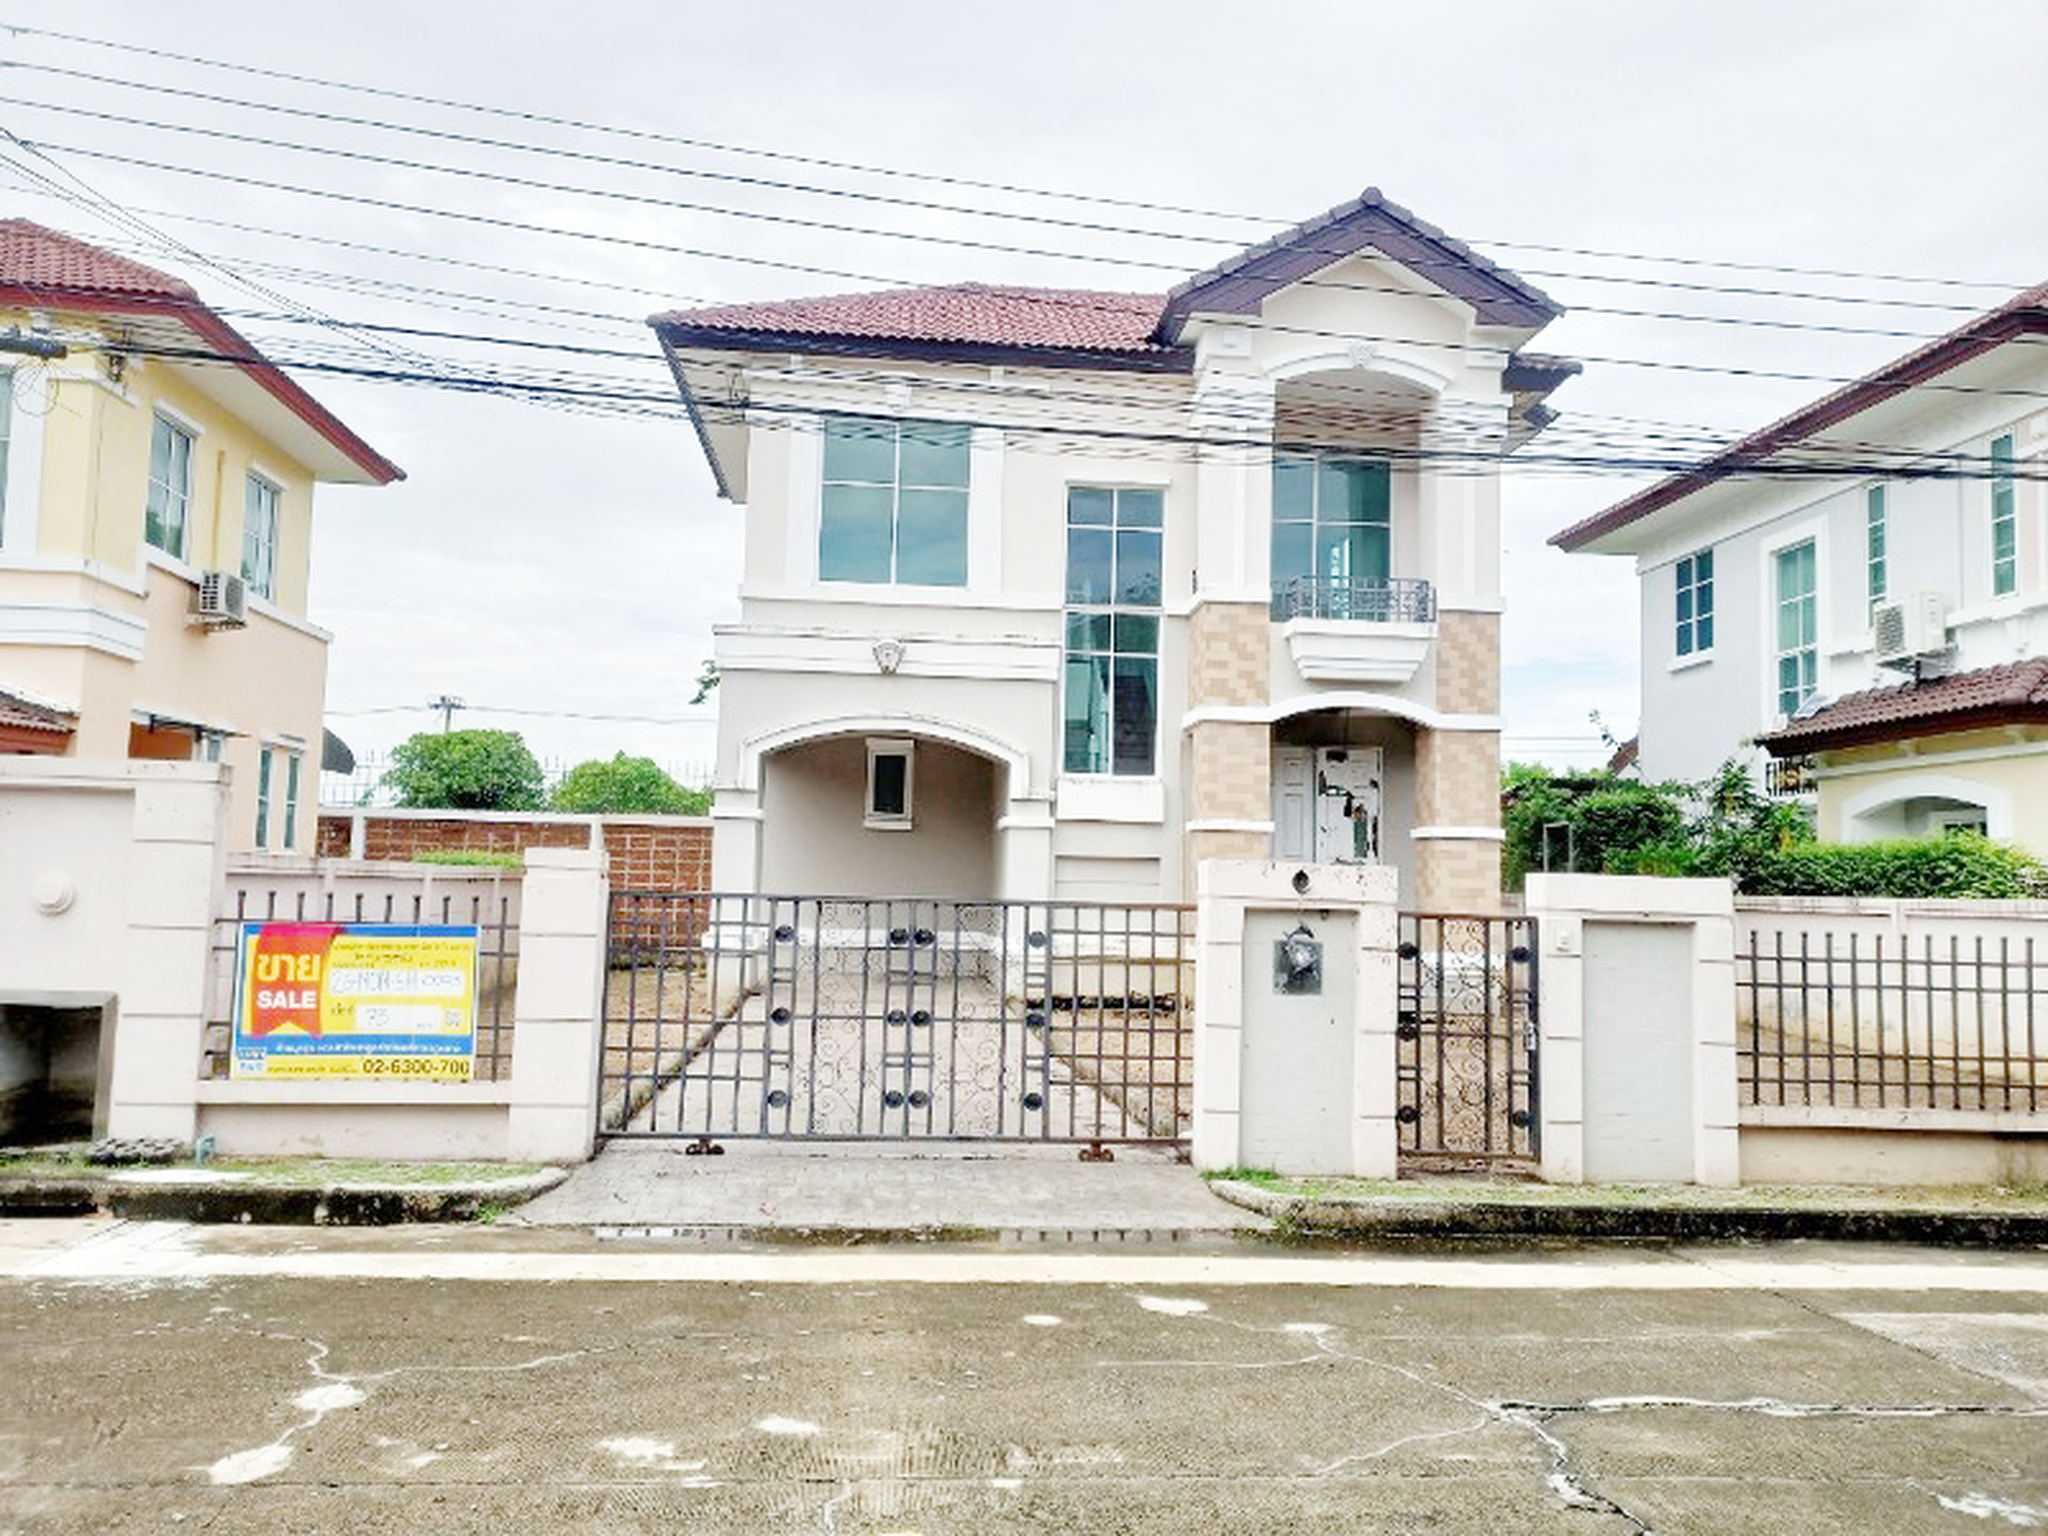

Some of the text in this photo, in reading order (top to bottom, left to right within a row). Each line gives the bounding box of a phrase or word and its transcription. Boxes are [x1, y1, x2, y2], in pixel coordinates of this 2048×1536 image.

[257, 953, 321, 982] ขาย
[256, 990, 318, 1010] SALE
[362, 1058, 470, 1075] 02-6300-700
